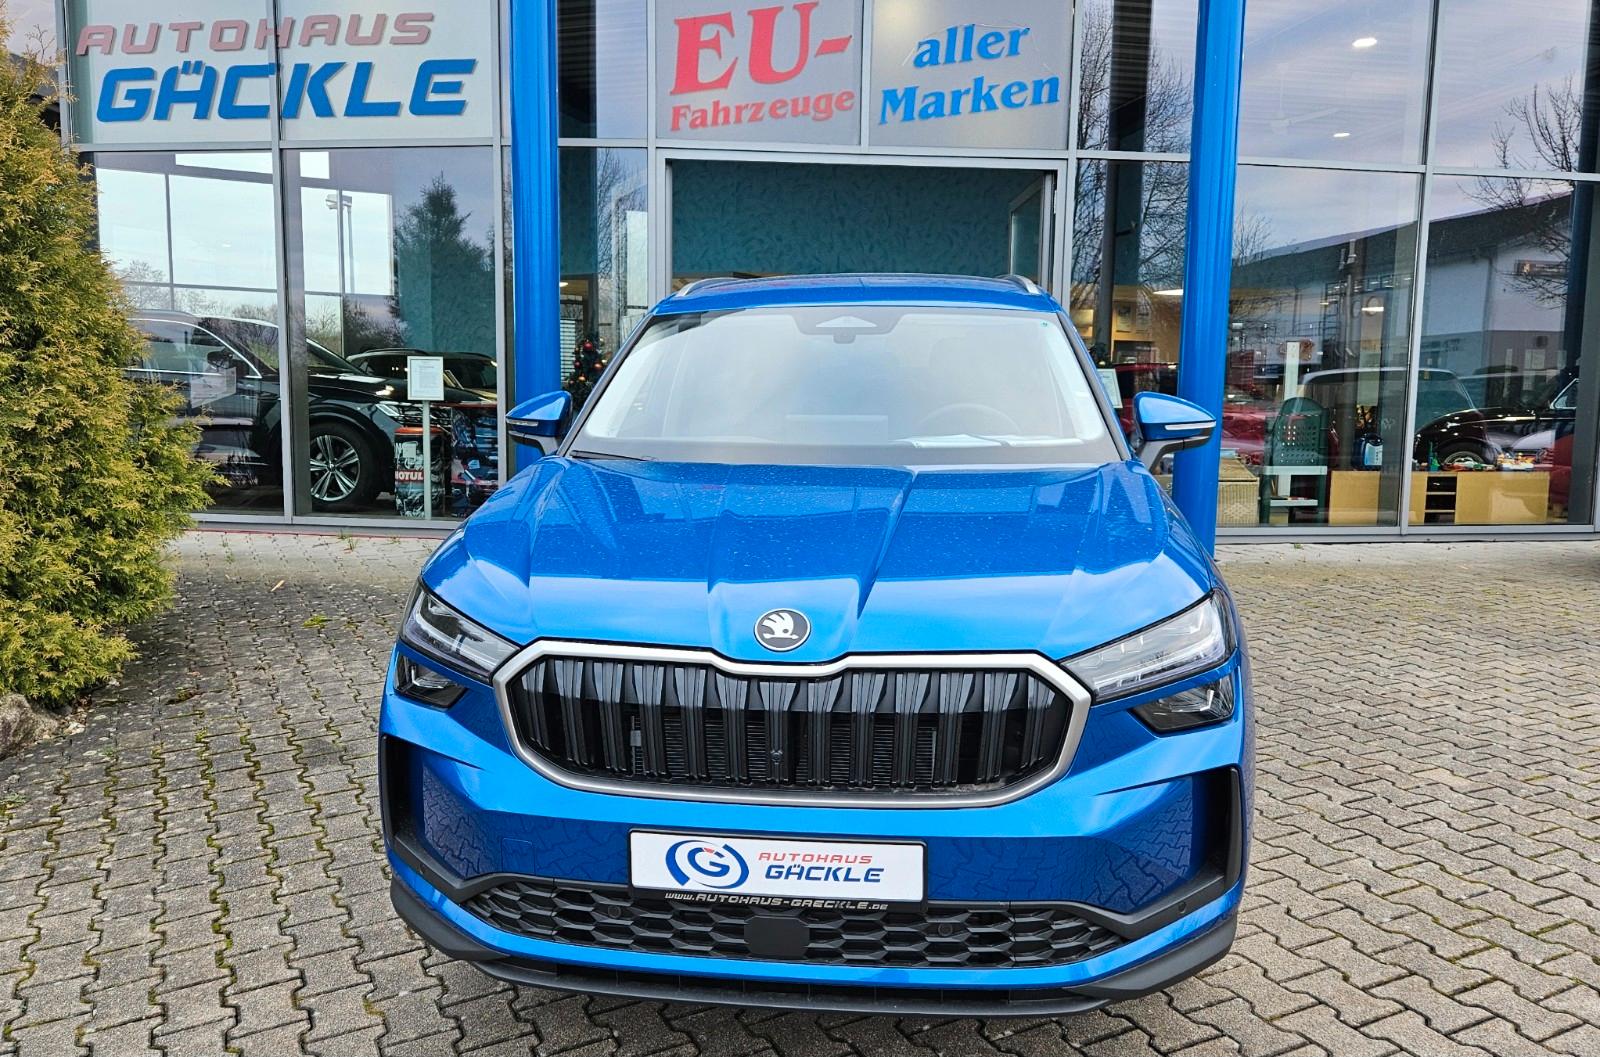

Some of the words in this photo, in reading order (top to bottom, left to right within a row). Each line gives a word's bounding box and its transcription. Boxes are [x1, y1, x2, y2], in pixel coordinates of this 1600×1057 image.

[75, 12, 435, 56] AUTOHAUS
[669, 1, 852, 96] EU-
[913, 23, 1031, 68] aller
[96, 59, 477, 123] GÄCKLE
[669, 89, 856, 132] Fahrzeuge
[878, 74, 1060, 126] Marken
[758, 852, 873, 864] AUTOHAUS
[765, 864, 885, 883] GÄCKLE
